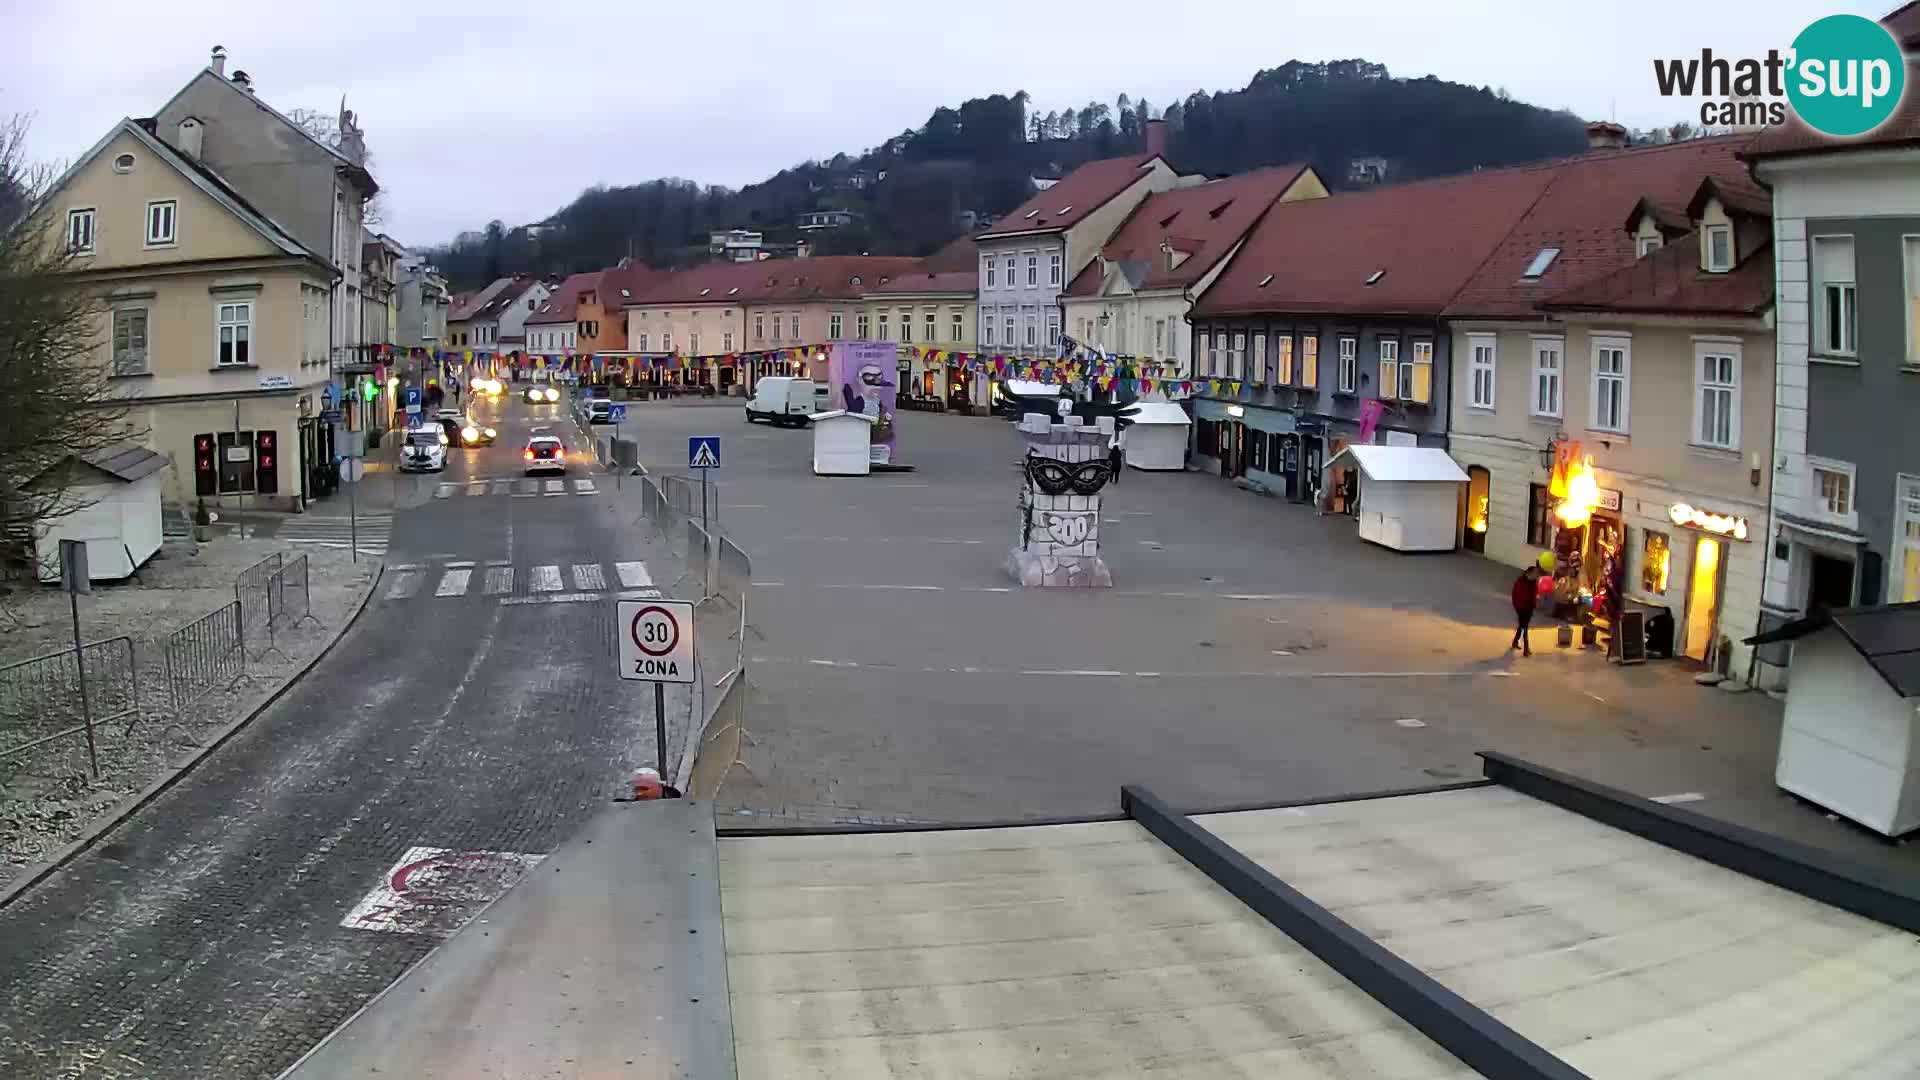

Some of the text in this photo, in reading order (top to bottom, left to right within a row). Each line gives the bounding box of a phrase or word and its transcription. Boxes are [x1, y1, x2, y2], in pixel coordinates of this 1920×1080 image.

[409, 391, 416, 402] P
[645, 622, 668, 643] 30
[635, 660, 678, 676] ZONA
